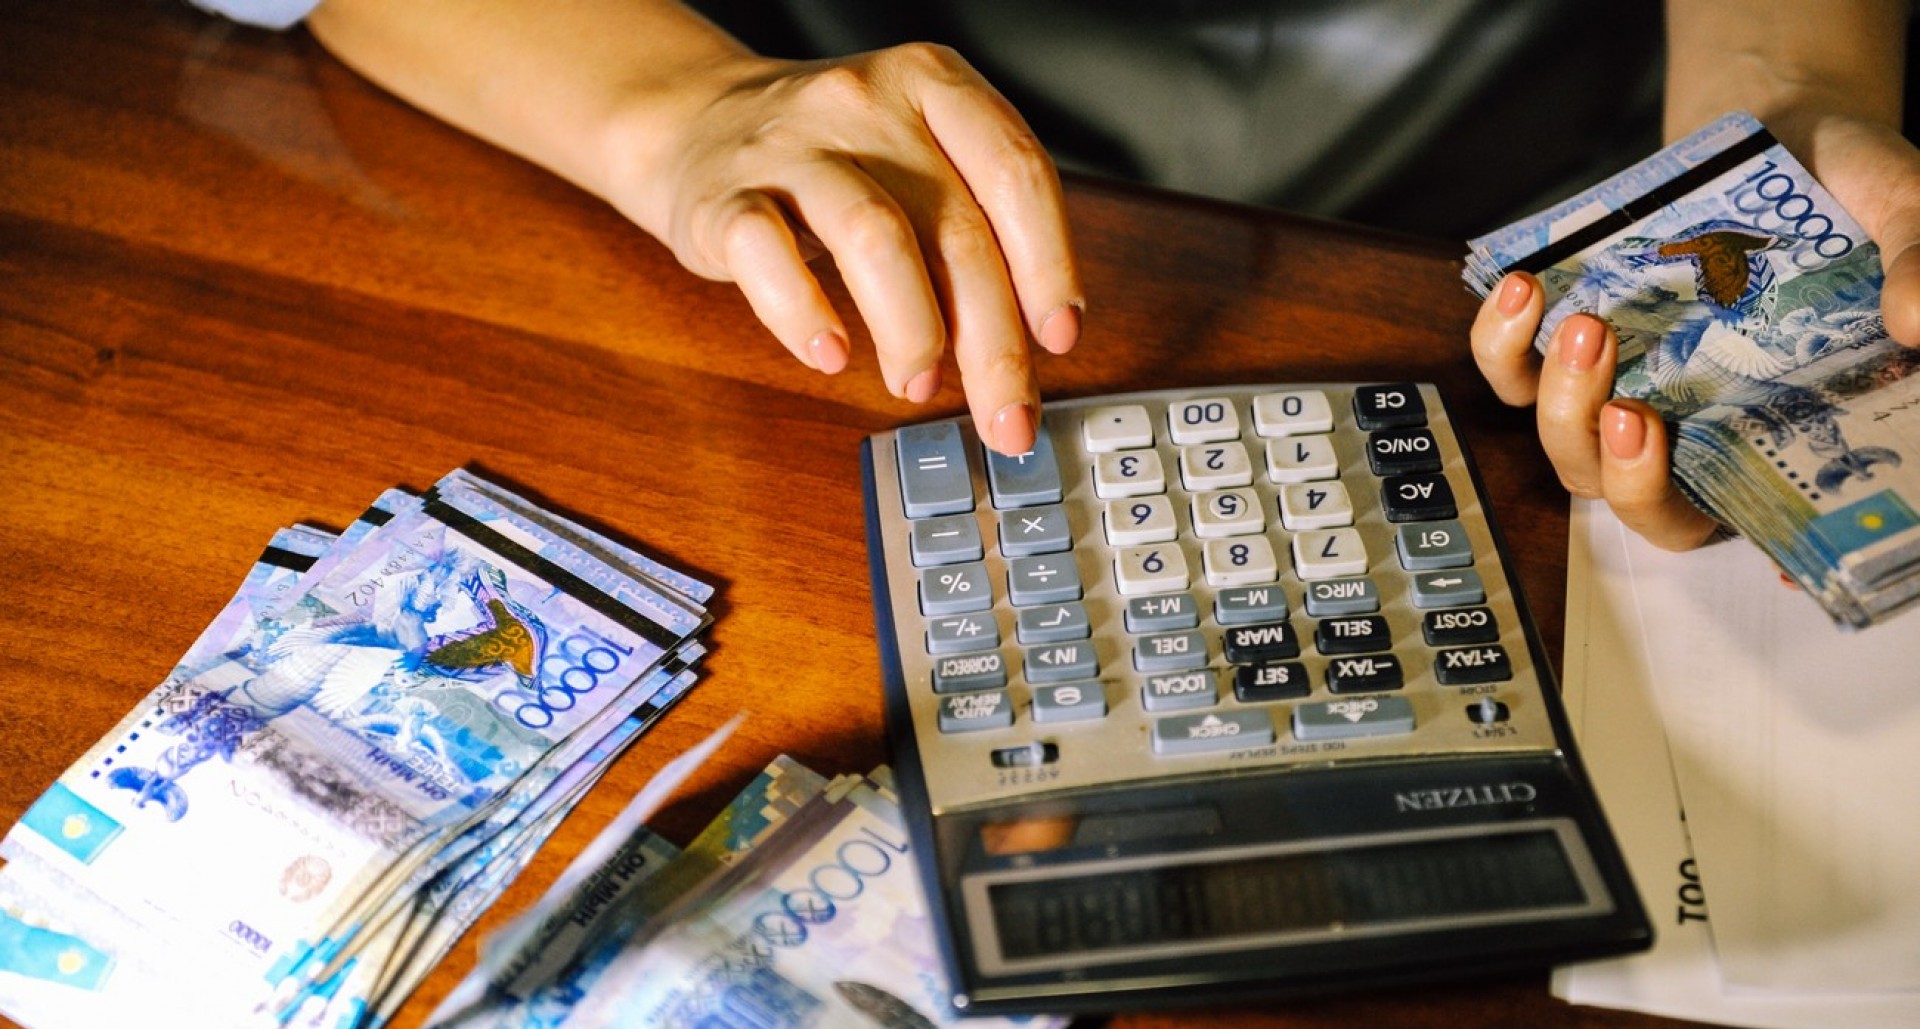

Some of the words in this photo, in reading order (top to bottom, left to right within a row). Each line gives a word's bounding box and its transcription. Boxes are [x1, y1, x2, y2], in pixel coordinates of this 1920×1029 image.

[1745, 159, 1853, 261] 10000
[1282, 396, 1302, 416] 0
[1375, 392, 1406, 409] CE
[1183, 402, 1224, 425] 00
[1295, 442, 1311, 463] 1
[1376, 436, 1430, 454] ON/C
[1119, 456, 1139, 478] 3
[1205, 449, 1224, 471] 2
[1305, 488, 1328, 511] 4
[1399, 481, 1434, 499] AC
[1129, 503, 1152, 525] 6
[1217, 494, 1238, 516] 5
[1320, 535, 1339, 558] 7
[1418, 530, 1450, 549] GT
[1141, 550, 1164, 574] 9
[1229, 543, 1250, 566] 8
[940, 572, 971, 594] %
[1315, 581, 1365, 599] MRC
[1140, 597, 1181, 615] M+
[1330, 619, 1373, 636] SELL
[1433, 611, 1487, 630] COST
[1151, 636, 1188, 654] DEL
[1235, 626, 1283, 646] MAR
[941, 655, 1000, 677] CORRECT
[1337, 659, 1393, 678] -TAX
[1445, 649, 1502, 668] +TAX
[515, 634, 635, 730] 10000
[1151, 673, 1207, 695] LOCAL
[1254, 667, 1289, 685] SET
[947, 694, 1001, 708] REPLAY
[1327, 700, 1379, 715] CHECK
[953, 705, 996, 719] AUTO
[1188, 722, 1240, 738] CHECK
[1281, 743, 1318, 755] STEPS
[1395, 782, 1537, 813] CITIZEN
[756, 826, 908, 949] 10000
